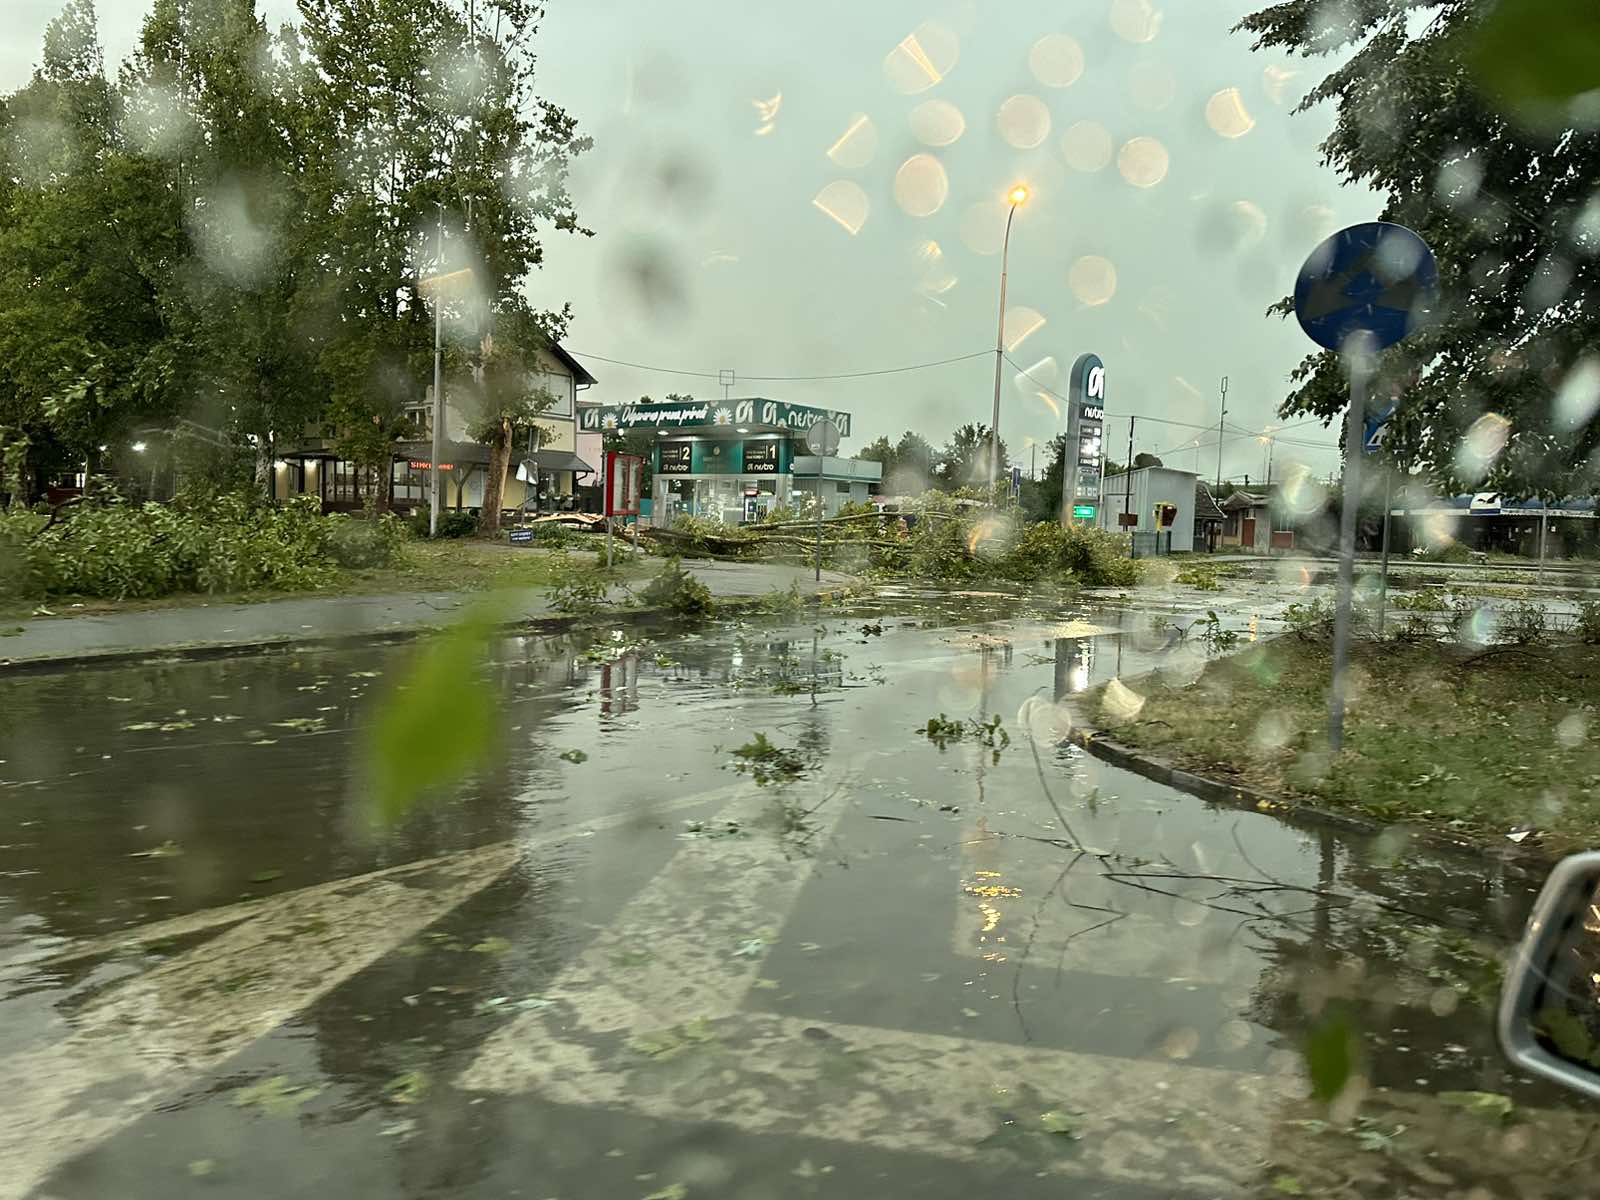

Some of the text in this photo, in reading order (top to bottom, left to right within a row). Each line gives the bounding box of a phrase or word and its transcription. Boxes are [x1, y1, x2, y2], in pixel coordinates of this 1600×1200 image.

[788, 410, 824, 428] nest
[682, 446, 691, 461] 2
[769, 444, 776, 460] 1
